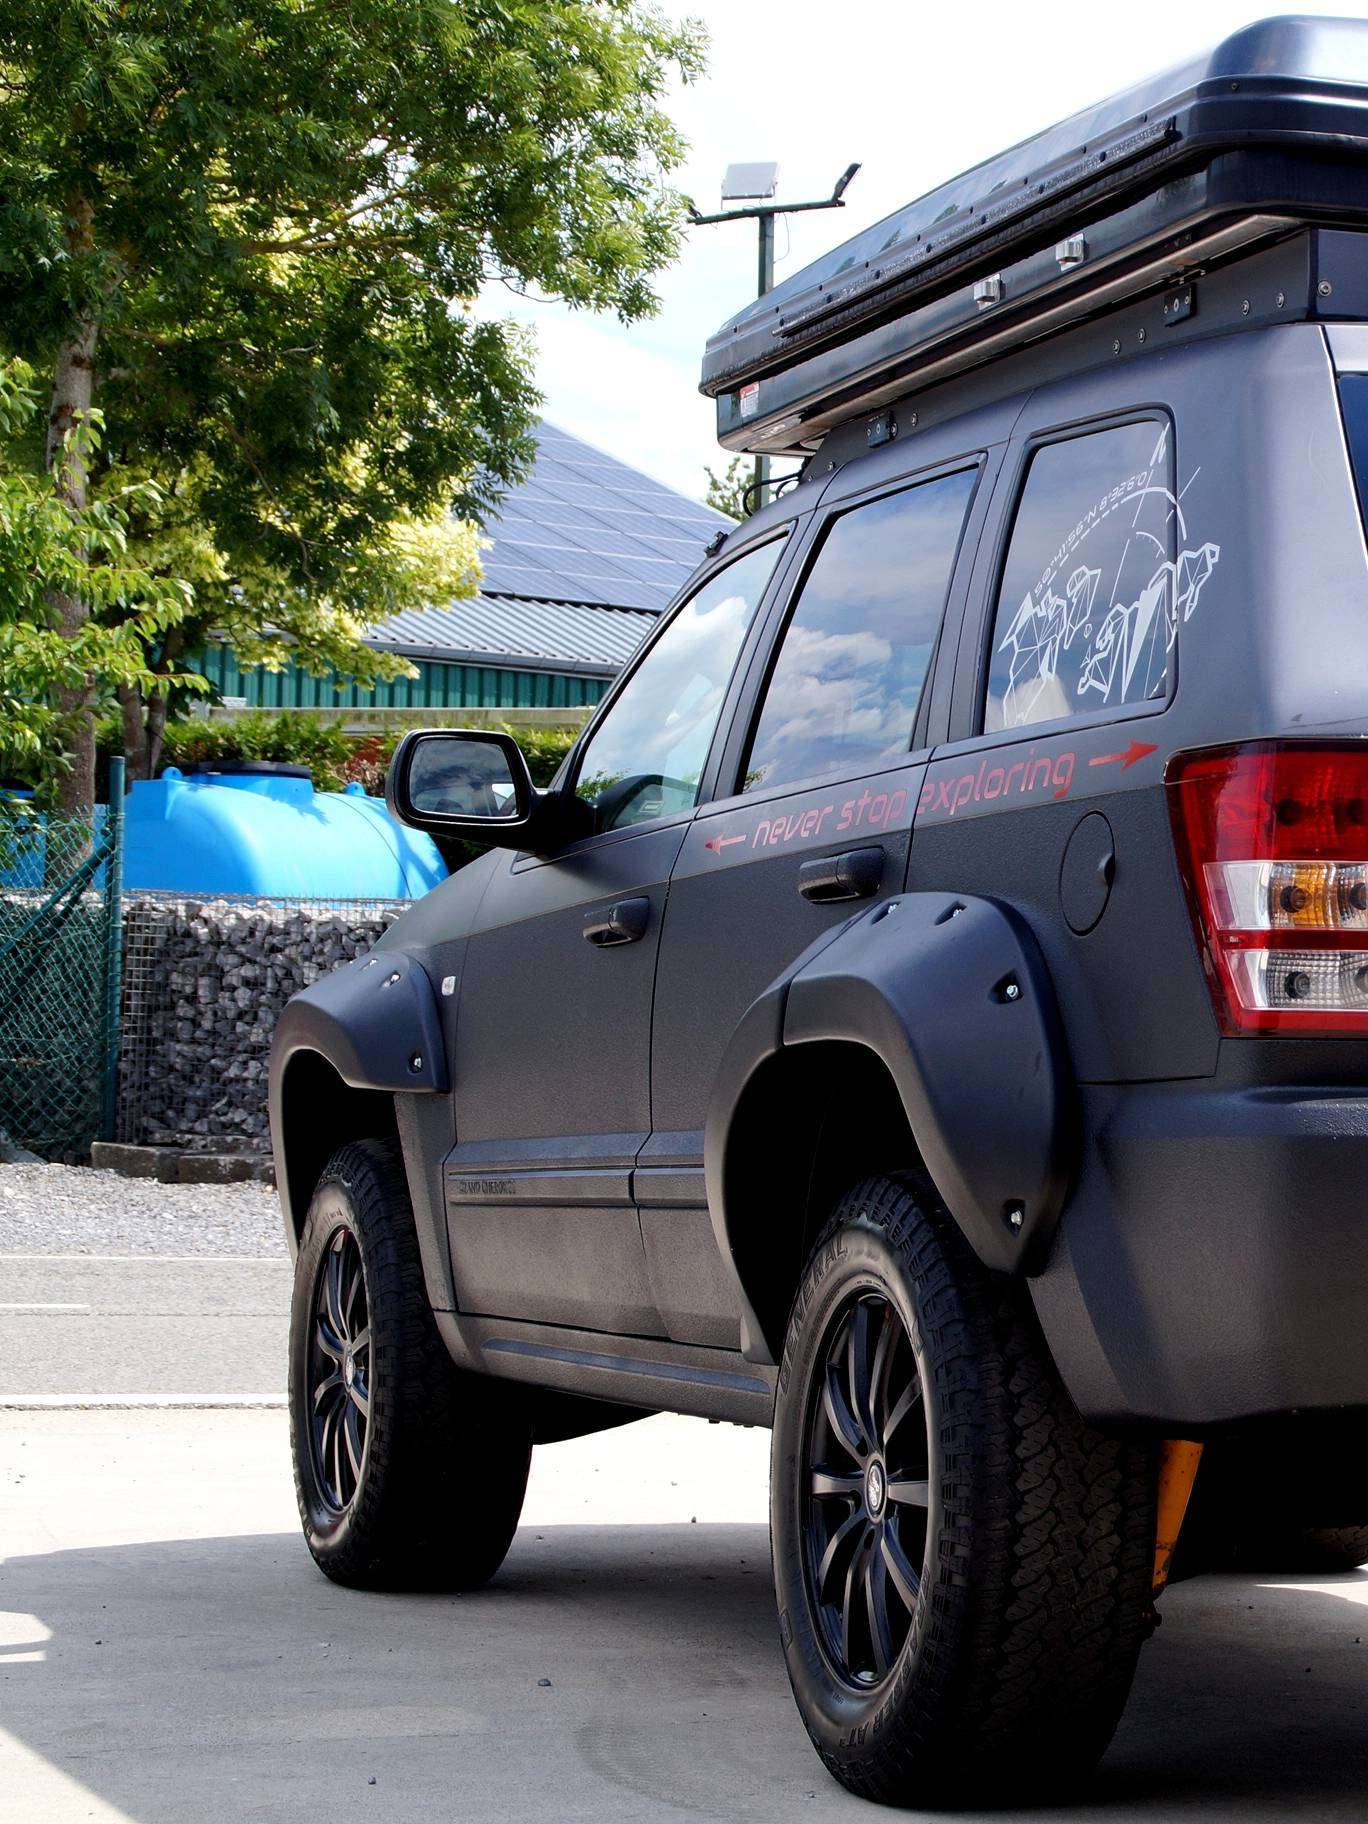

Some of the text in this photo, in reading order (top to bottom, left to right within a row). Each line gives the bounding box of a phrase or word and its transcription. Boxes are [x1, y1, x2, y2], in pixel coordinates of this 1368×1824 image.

[752, 748, 1076, 848] never stop exploring
